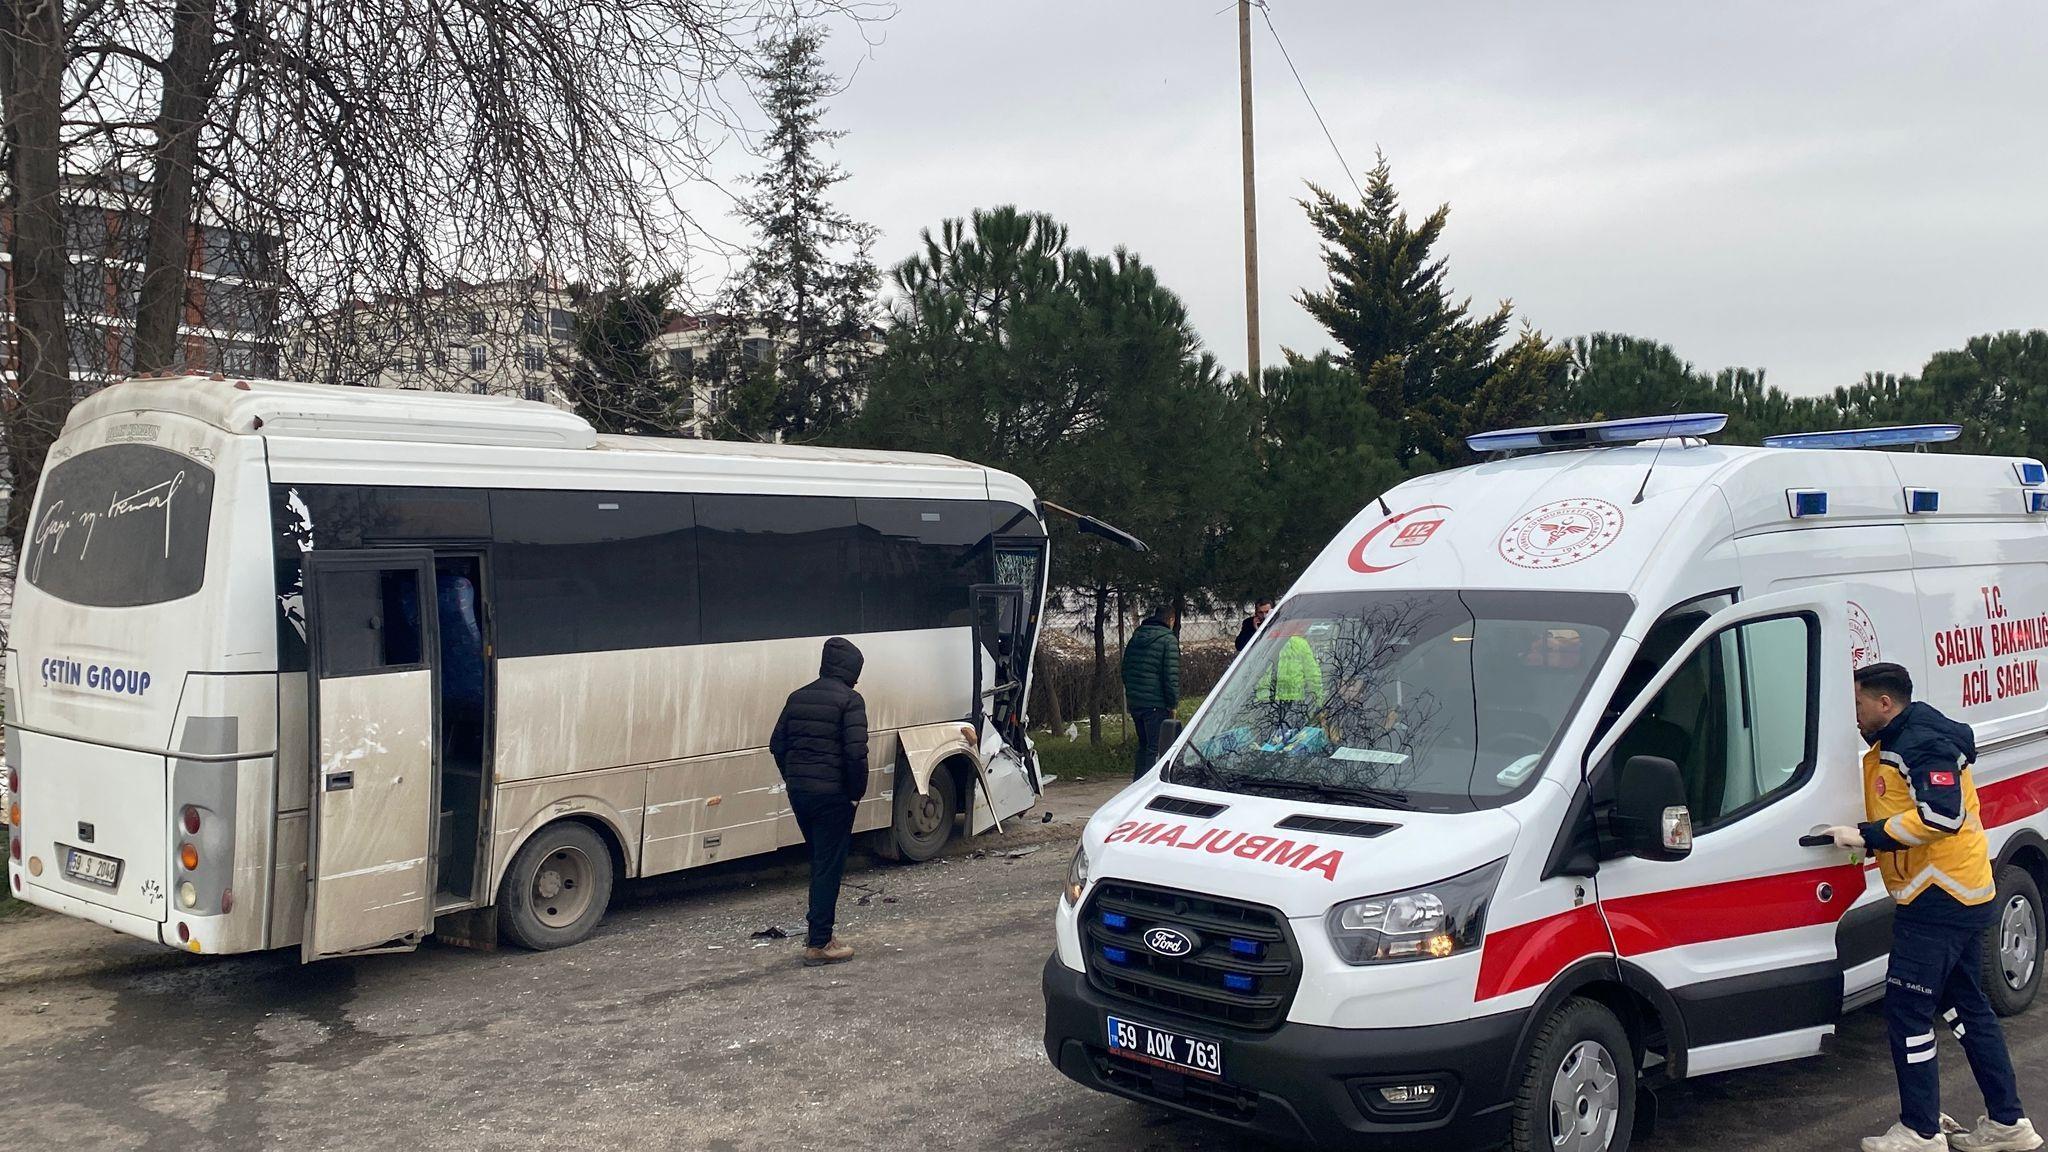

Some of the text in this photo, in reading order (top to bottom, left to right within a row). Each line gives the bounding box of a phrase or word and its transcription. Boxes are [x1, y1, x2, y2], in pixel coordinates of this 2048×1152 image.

[1404, 523, 1435, 537] 112
[1981, 586, 2008, 619] T.C.
[1935, 623, 1986, 667] SAĞLIK
[41, 656, 151, 696] ÇETİN GROUP
[1962, 657, 2040, 708] ACİL SAĞLIK
[86, 857, 92, 873] S
[1151, 931, 1182, 952] Ford
[1118, 1022, 1137, 1049] 59
[1146, 1030, 1176, 1060] AOK
[1185, 1038, 1217, 1070] 763
